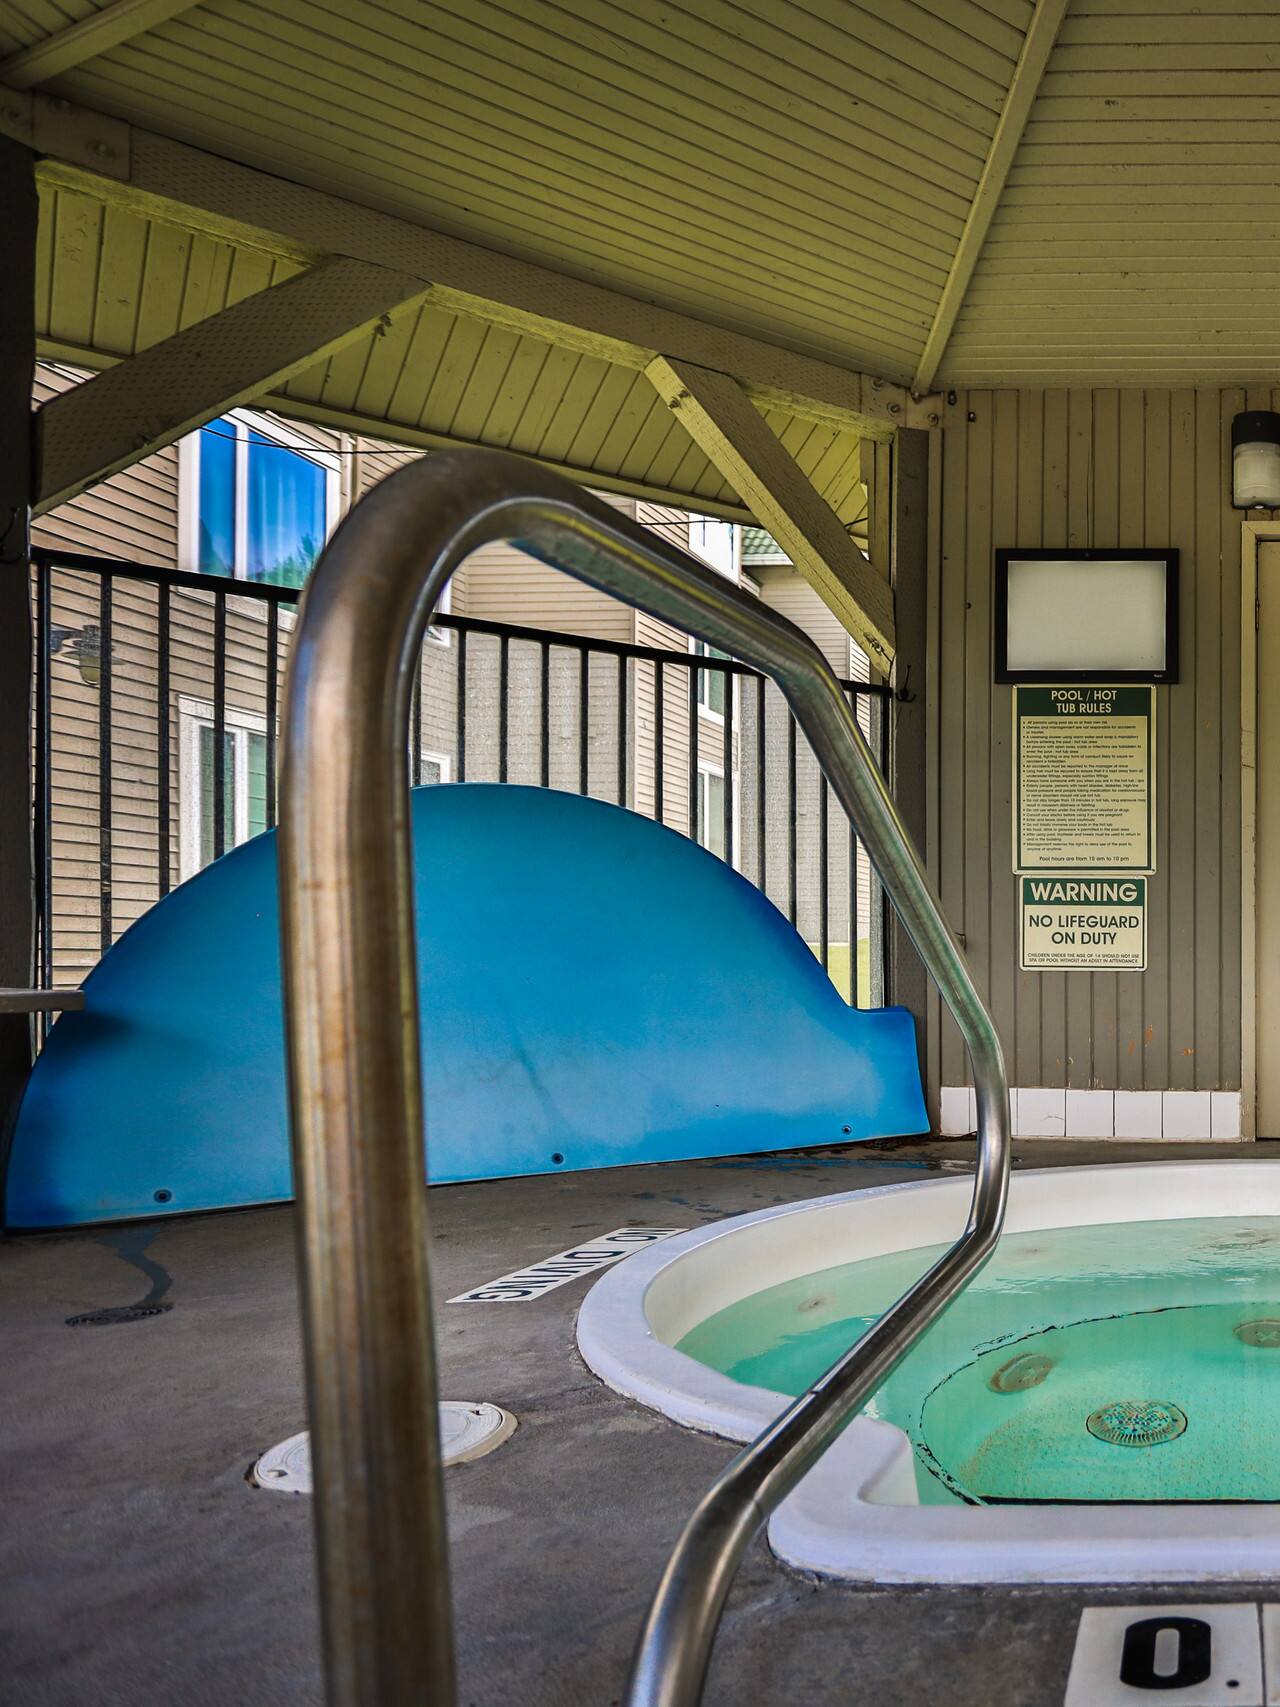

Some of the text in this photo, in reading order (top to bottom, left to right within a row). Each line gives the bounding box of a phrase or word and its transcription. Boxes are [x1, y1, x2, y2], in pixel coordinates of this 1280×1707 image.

[1051, 690, 1083, 700] POOL
[1094, 690, 1117, 700] HOT
[1056, 703, 1112, 713] TUB RULES
[1030, 882, 1138, 902] WARNING
[1029, 915, 1139, 928] NO LIFEGUARD
[1051, 932, 1117, 944] ON DUTY
[605, 1228, 677, 1242] NO
[463, 1250, 626, 1301] DIVING
